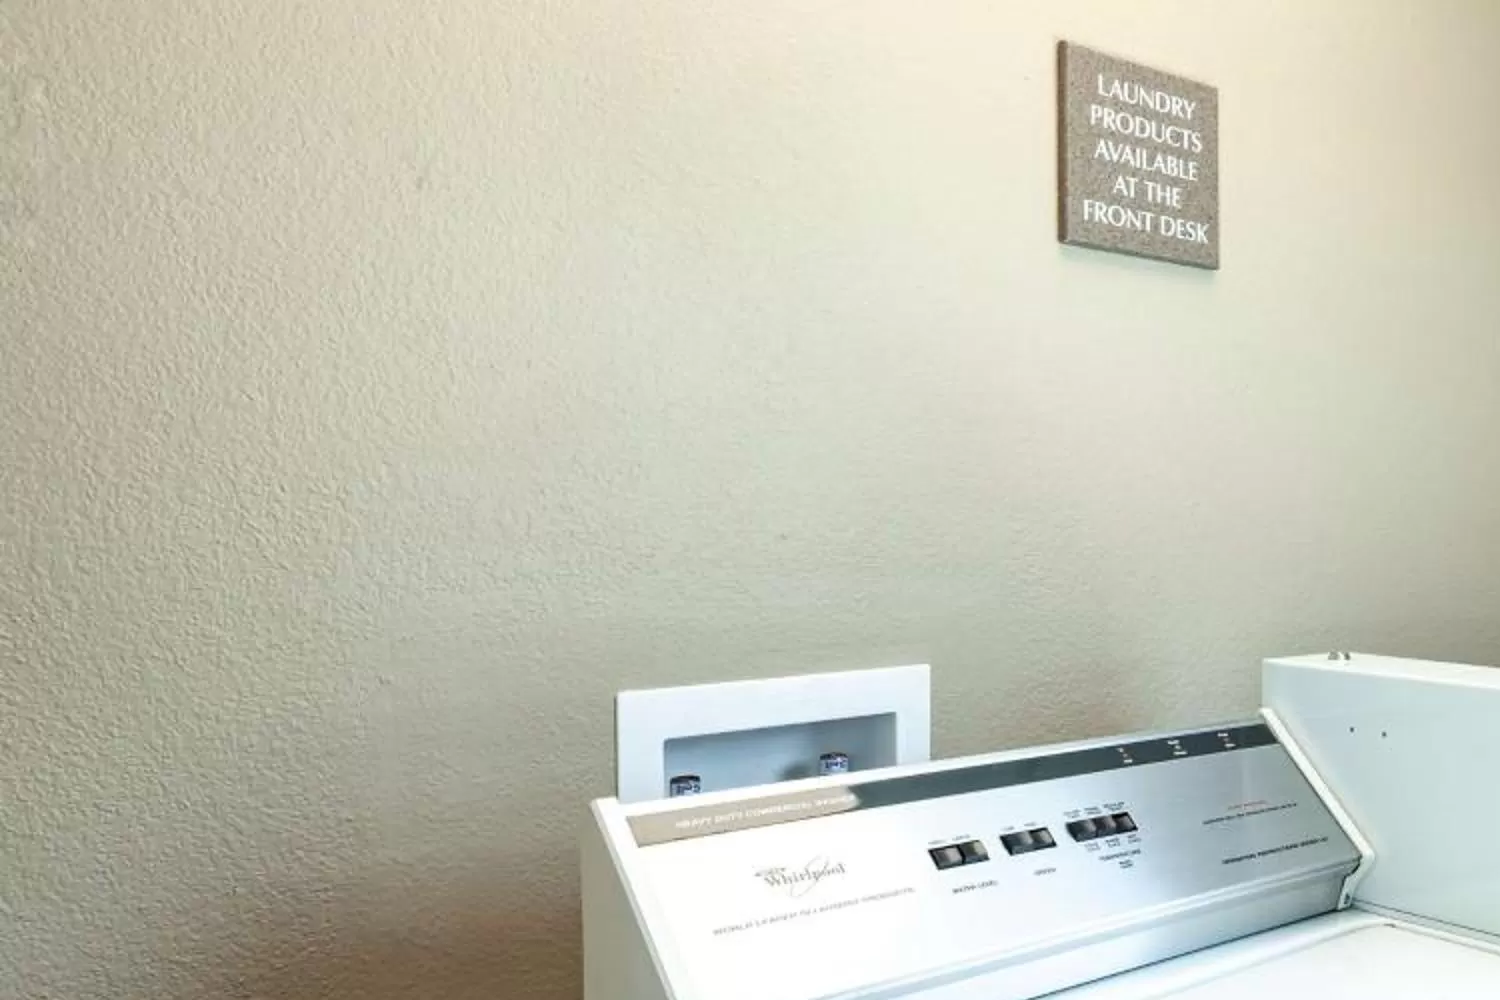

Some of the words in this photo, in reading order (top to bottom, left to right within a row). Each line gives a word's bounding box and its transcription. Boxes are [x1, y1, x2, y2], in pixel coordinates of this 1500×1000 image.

[1097, 73, 1196, 121] LAUNDRY
[1090, 103, 1203, 154] PRODUCTS
[1094, 138, 1199, 182] AVAILABLE
[1112, 174, 1138, 198] AT
[1144, 179, 1182, 209] THE
[1083, 199, 1155, 233] FRONT
[1160, 215, 1210, 244] DESK
[763, 862, 846, 887] Whirlpool
